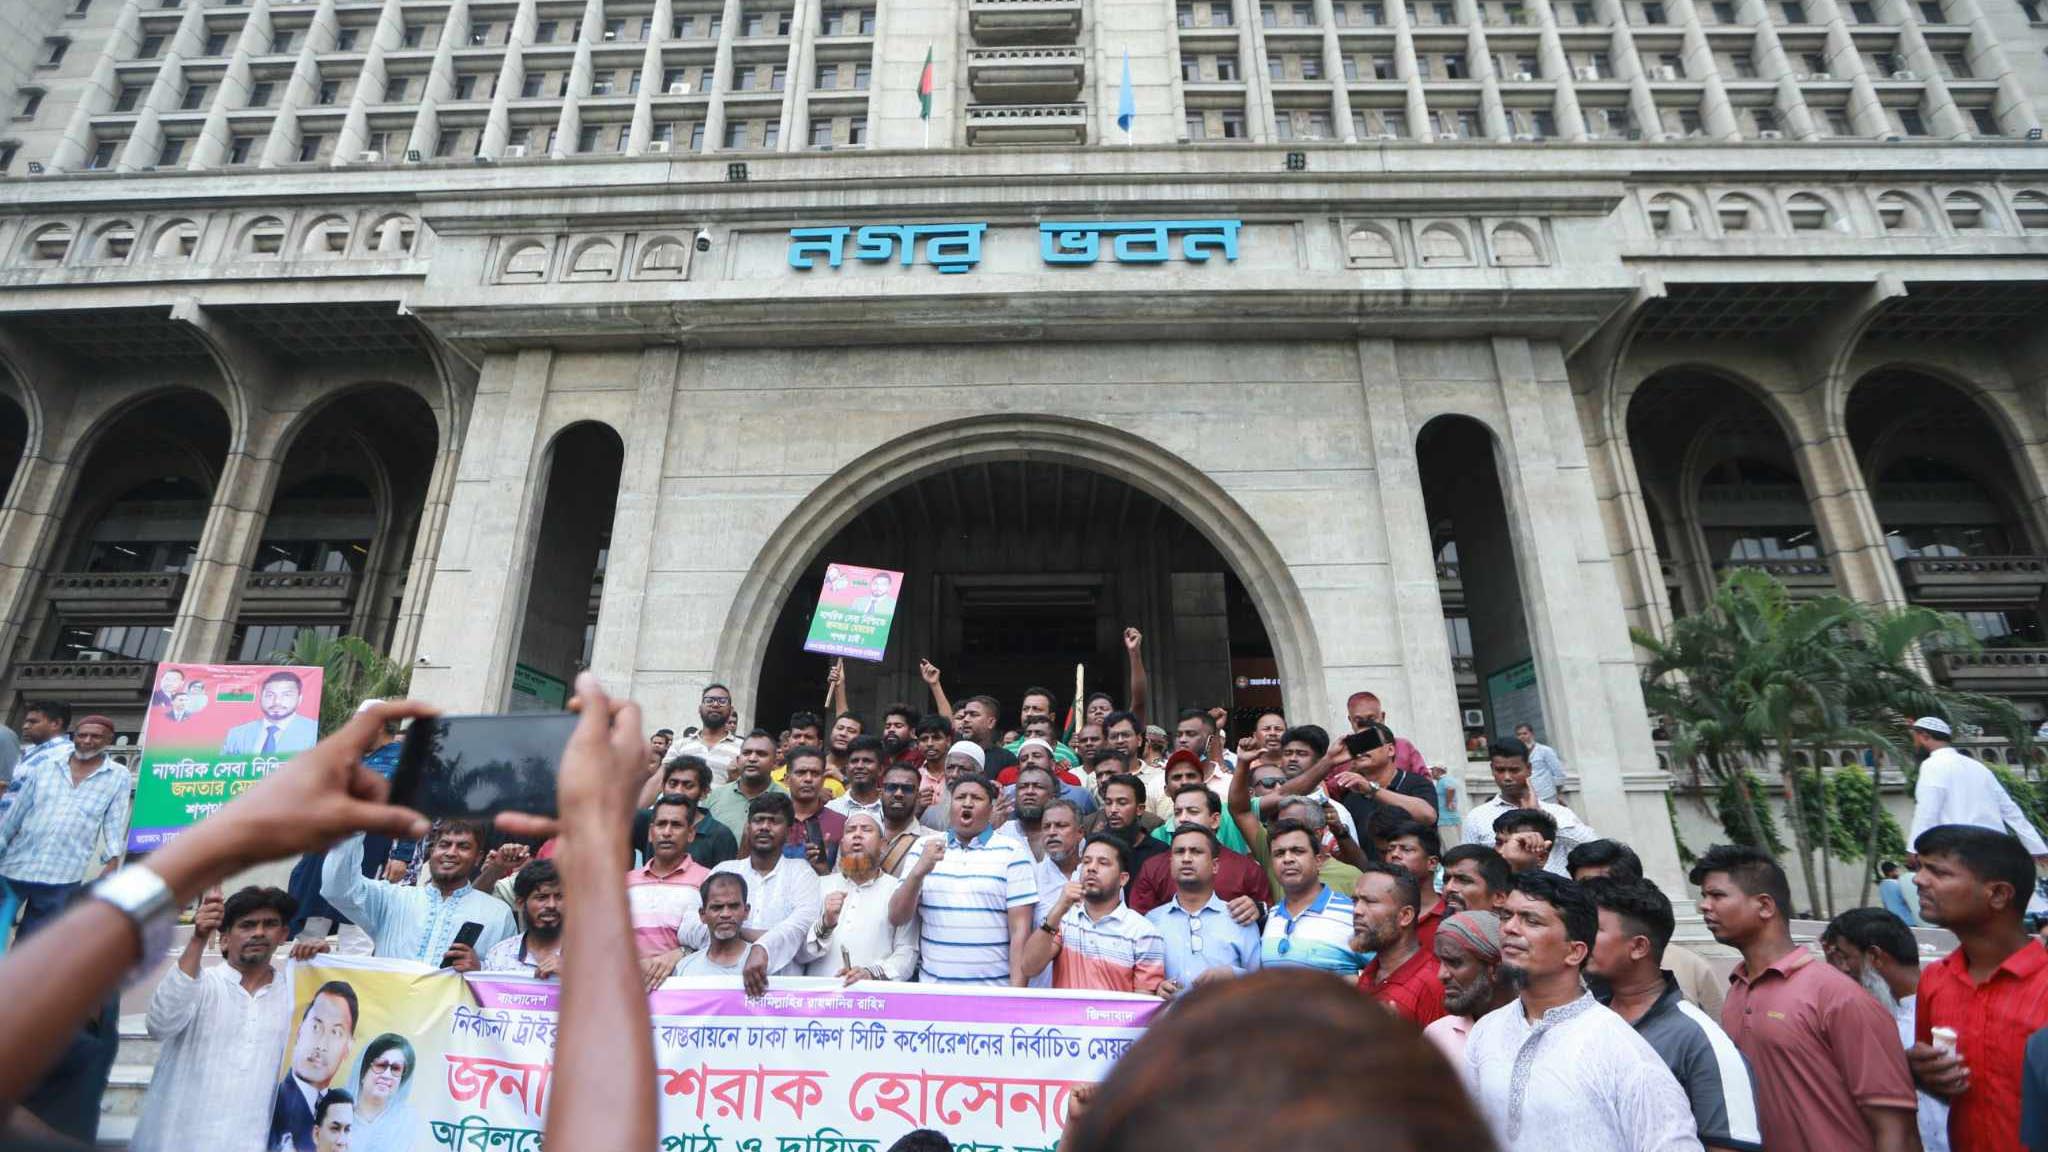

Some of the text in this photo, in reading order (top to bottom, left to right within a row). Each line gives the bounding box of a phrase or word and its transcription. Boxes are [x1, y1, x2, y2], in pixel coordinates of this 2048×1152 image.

[789, 220, 1243, 274] নগর ভবন
[152, 758, 209, 779] নাগরিক
[213, 761, 248, 778] সেবা
[171, 780, 226, 797] জনতার
[452, 1006, 513, 1042] নির্বাচনী
[660, 1025, 742, 1049] বাস্তবায়নে
[746, 1026, 787, 1050] ঢাকা
[794, 1020, 844, 1050] দক্ষিণ
[849, 1021, 887, 1052] সিটি
[893, 1024, 1004, 1056] কর্পোরেশনের
[1010, 1027, 1082, 1059] নির্বাচিত
[444, 1054, 552, 1117] জনা
[656, 1061, 831, 1122] শরাক
